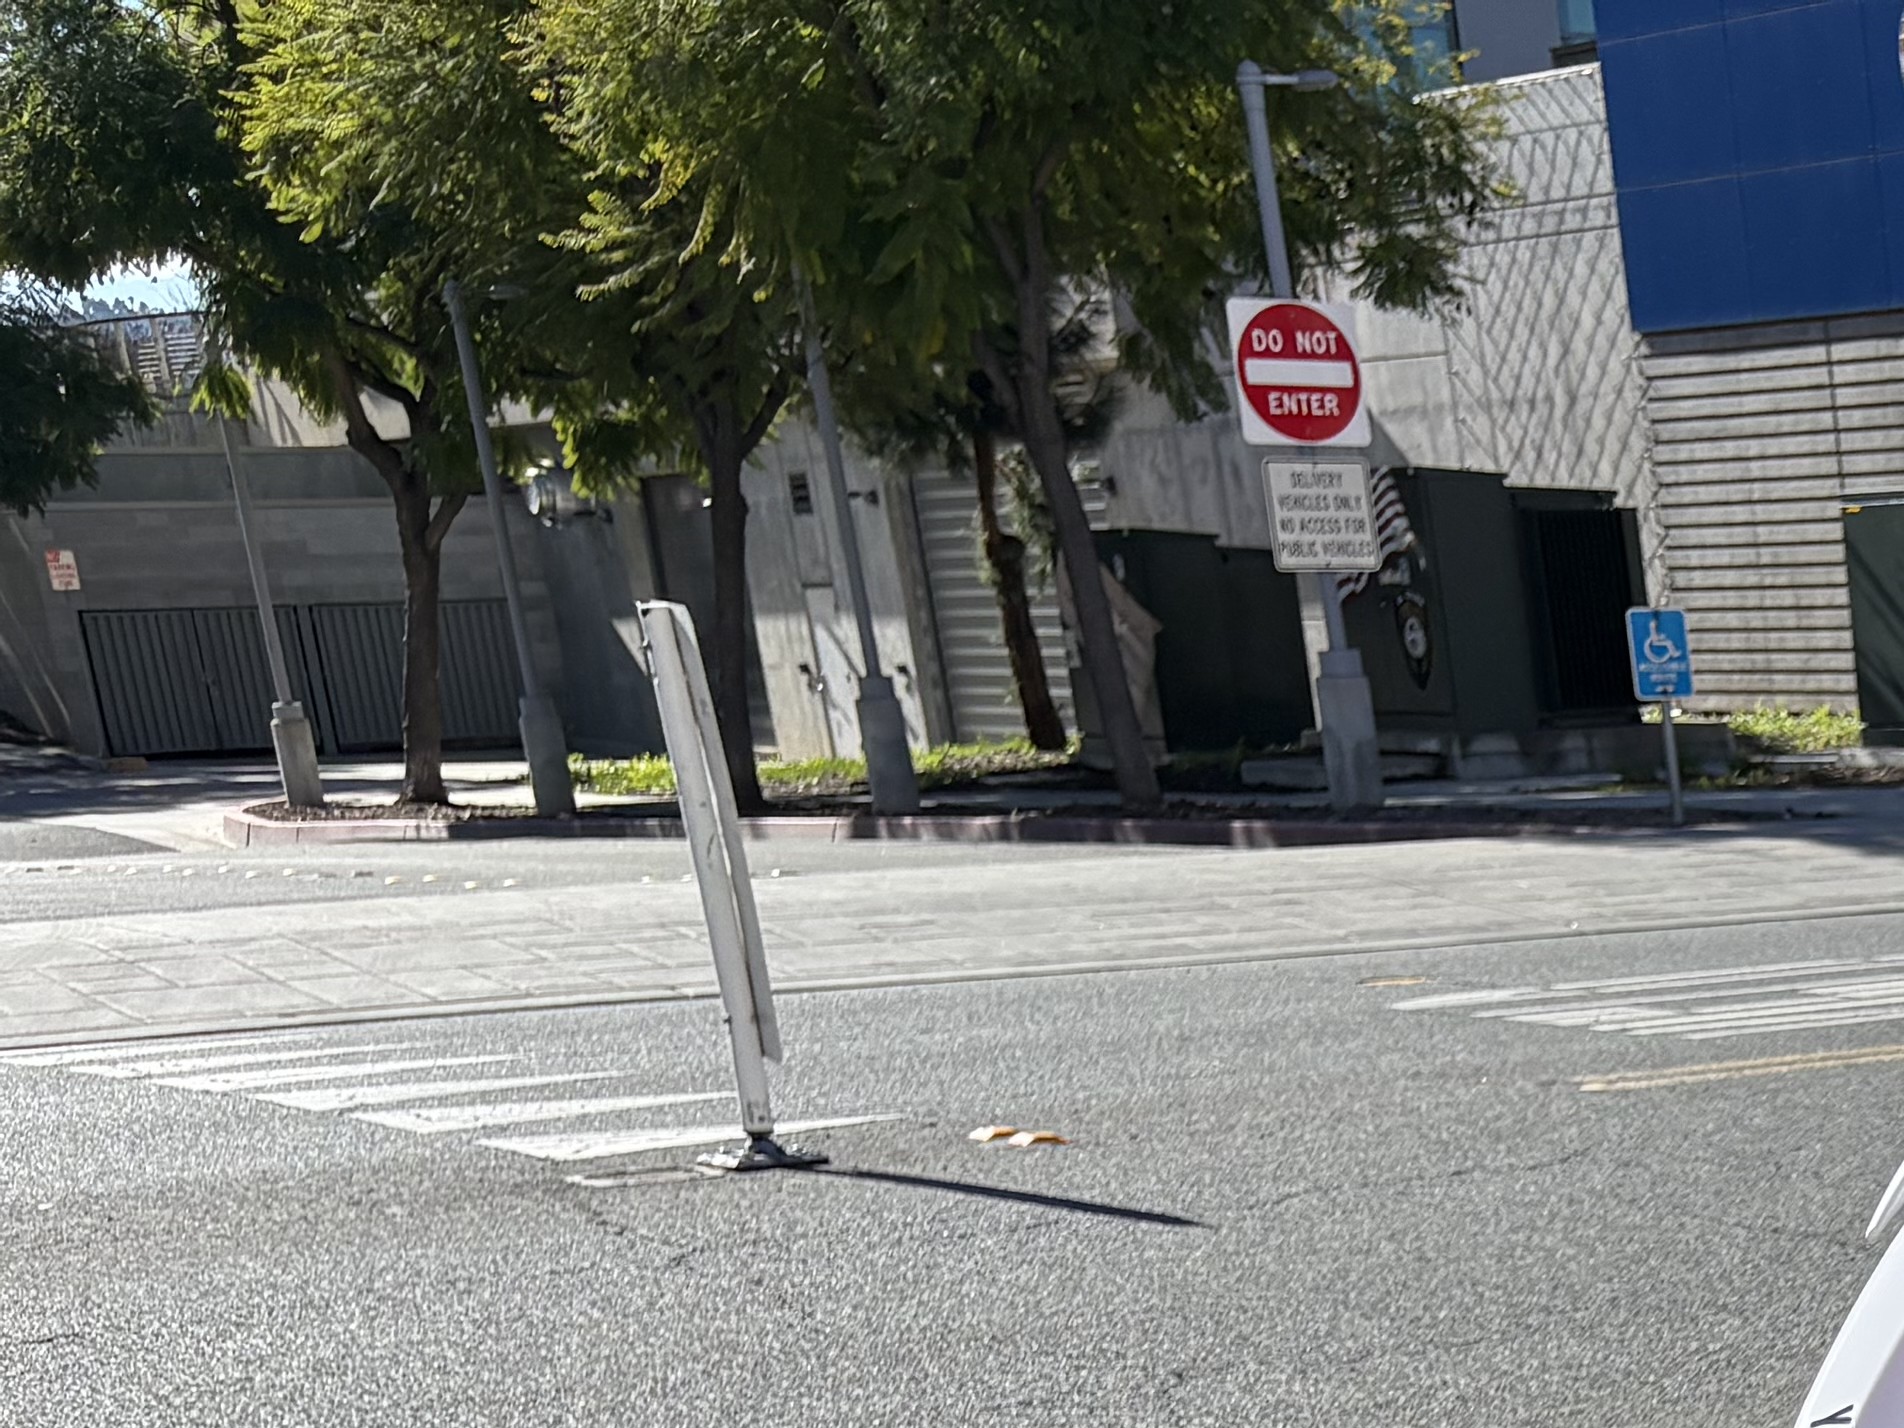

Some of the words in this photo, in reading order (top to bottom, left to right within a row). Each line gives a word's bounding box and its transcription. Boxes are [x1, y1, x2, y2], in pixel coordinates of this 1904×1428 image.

[1252, 328, 1284, 353] DO
[1295, 330, 1338, 355] NOT
[1268, 391, 1340, 417] ENTER
